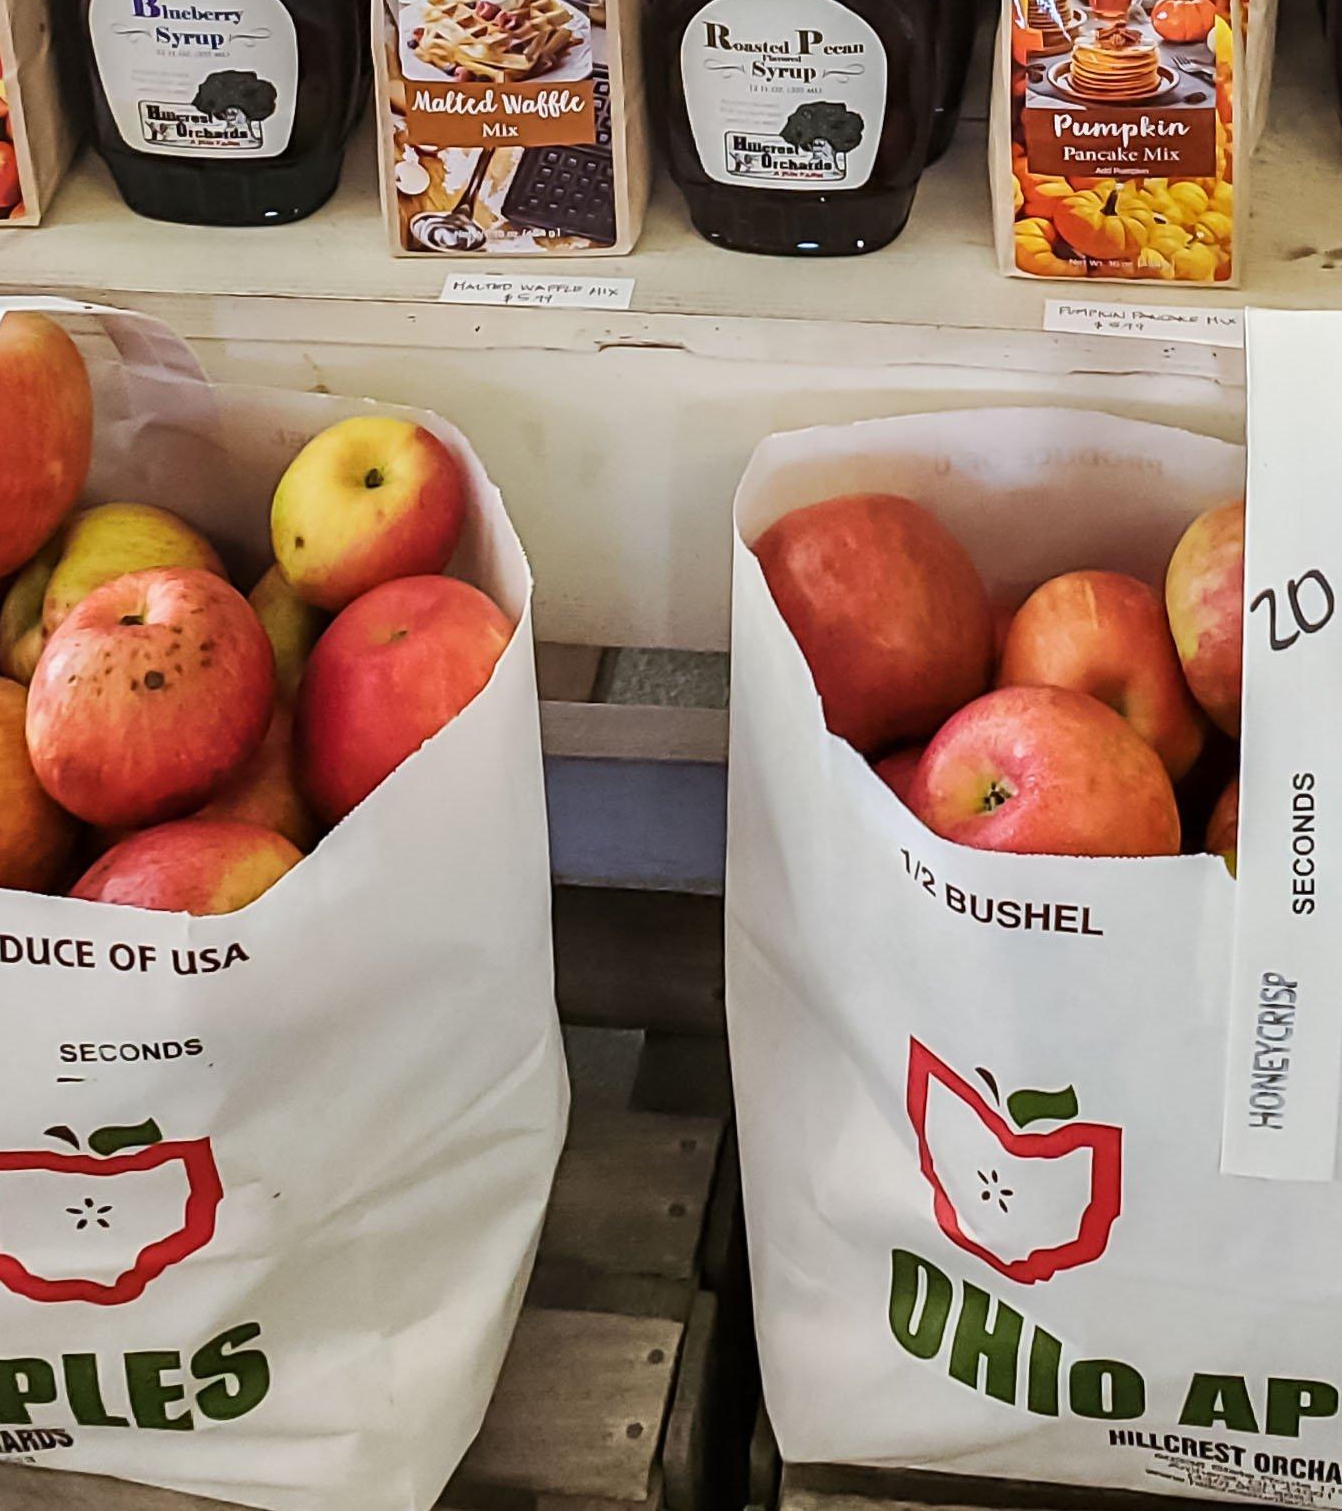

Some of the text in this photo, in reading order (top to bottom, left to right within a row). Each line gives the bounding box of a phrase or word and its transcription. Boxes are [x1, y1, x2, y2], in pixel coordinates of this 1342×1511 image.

[156, 26, 224, 49] Syrup
[702, 21, 864, 55] Roasted Pecan
[752, 60, 816, 83] Syrup
[412, 89, 585, 119] Malted Waffle
[482, 122, 519, 138] Mix
[1054, 113, 1190, 148] Pumpkin
[1063, 146, 1180, 163] Pancake Mix
[1249, 569, 1335, 652] 20
[1292, 772, 1315, 915] SECONDS
[899, 848, 1104, 937] 1/2 BUSHEL
[108, 941, 158, 973] OF
[171, 941, 251, 976] USA
[59, 1037, 205, 1064] SECONDS
[1248, 970, 1298, 1130] HONEYCRISP
[888, 1248, 1146, 1420] OHIO
[1108, 1428, 1246, 1468] HILLCREST
